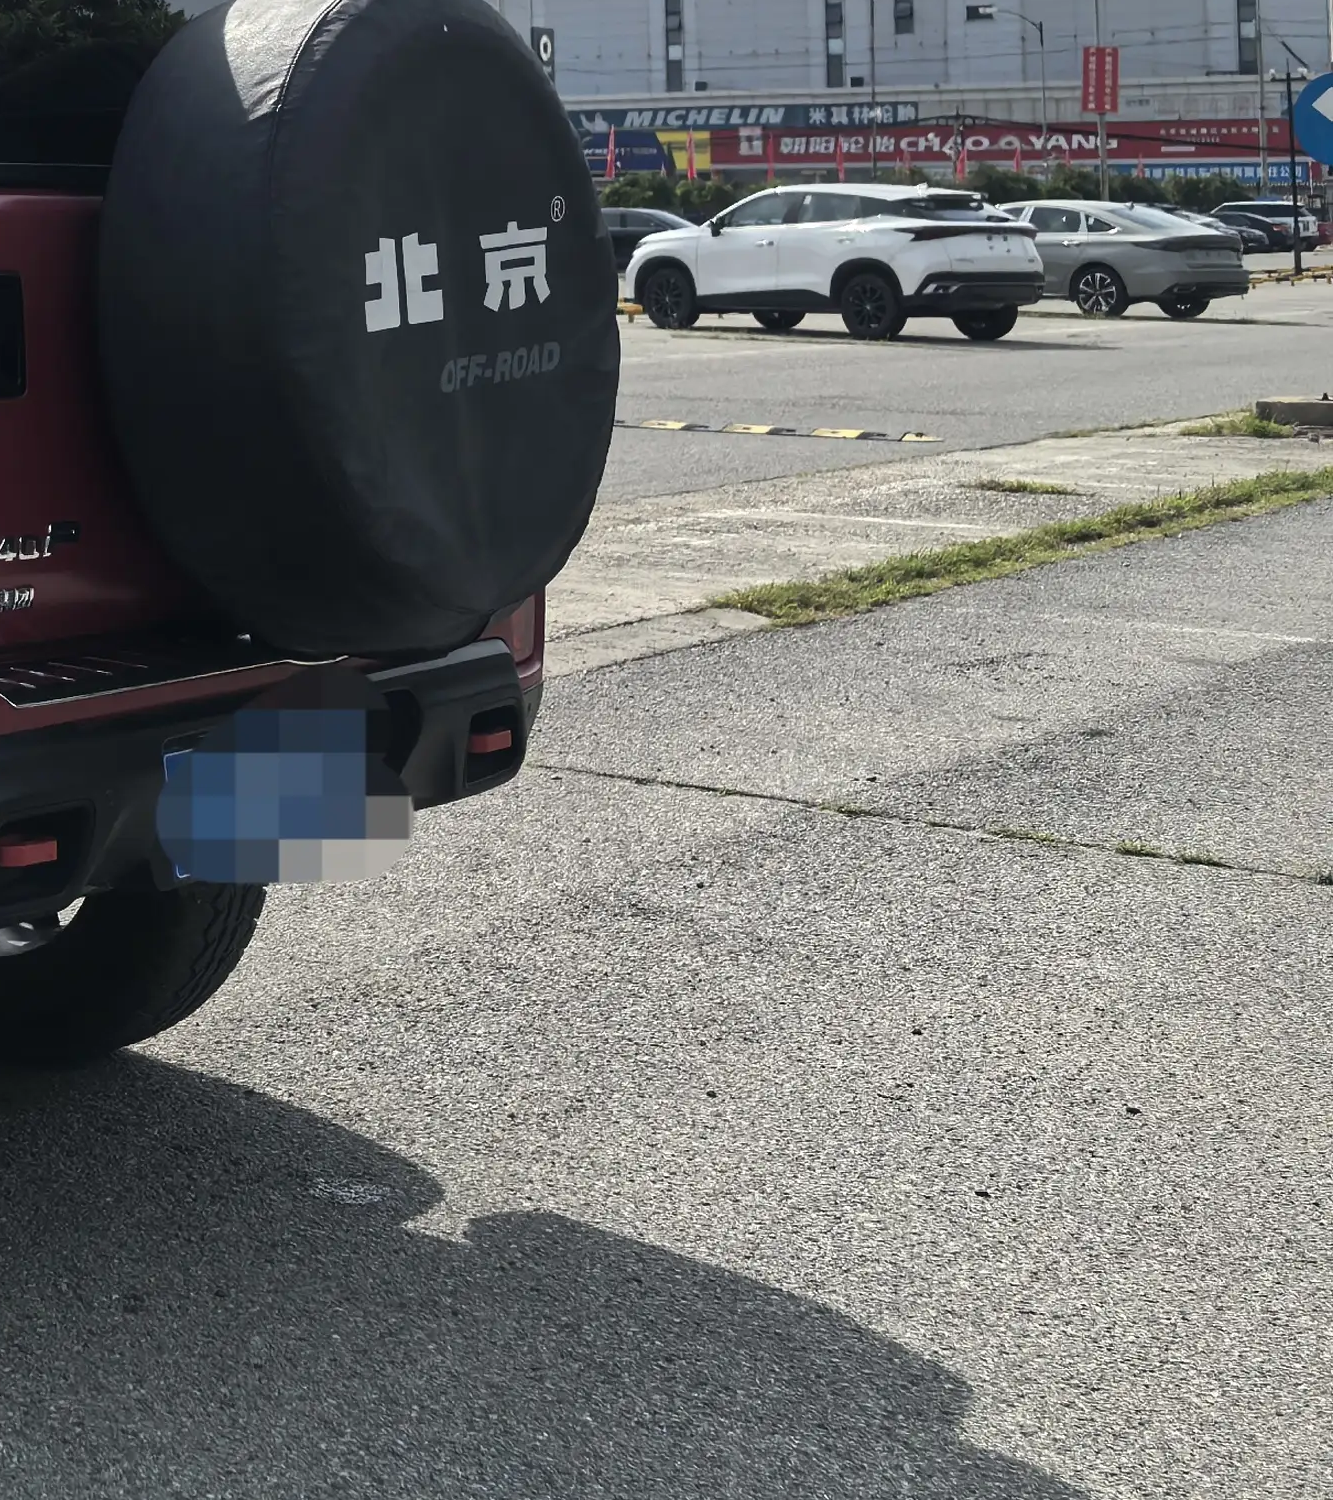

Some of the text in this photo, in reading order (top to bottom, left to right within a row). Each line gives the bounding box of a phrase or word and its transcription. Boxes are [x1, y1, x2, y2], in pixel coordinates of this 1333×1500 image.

[623, 106, 786, 127] MICHELIN
[364, 220, 551, 333] 北京
[440, 342, 561, 393] OFF-ROAD
